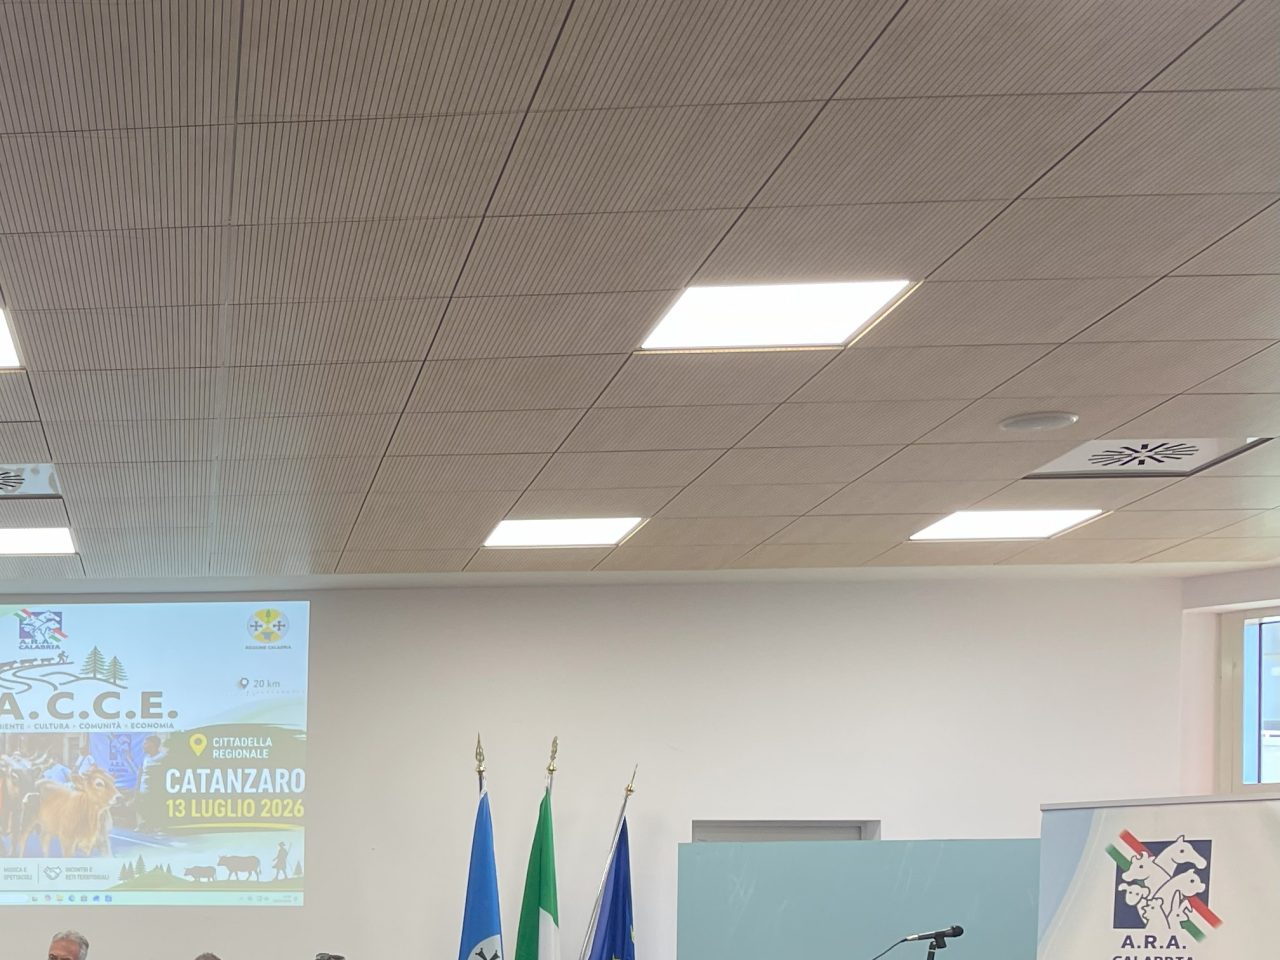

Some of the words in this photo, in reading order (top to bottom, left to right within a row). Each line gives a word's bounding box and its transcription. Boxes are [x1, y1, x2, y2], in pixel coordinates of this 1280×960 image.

[253, 680, 265, 688] 20
[267, 679, 280, 688] km
[34, 722, 69, 730] CULTURA
[79, 721, 122, 730] COMUNITÀ
[212, 737, 272, 747] CITTADELLA
[212, 749, 269, 759] REGIONALE
[165, 768, 306, 793] CATANZARO
[166, 799, 186, 817] 13
[191, 799, 255, 817] LUGLIO
[261, 799, 305, 817] 2026
[1121, 935, 1187, 950] A.R.A.
